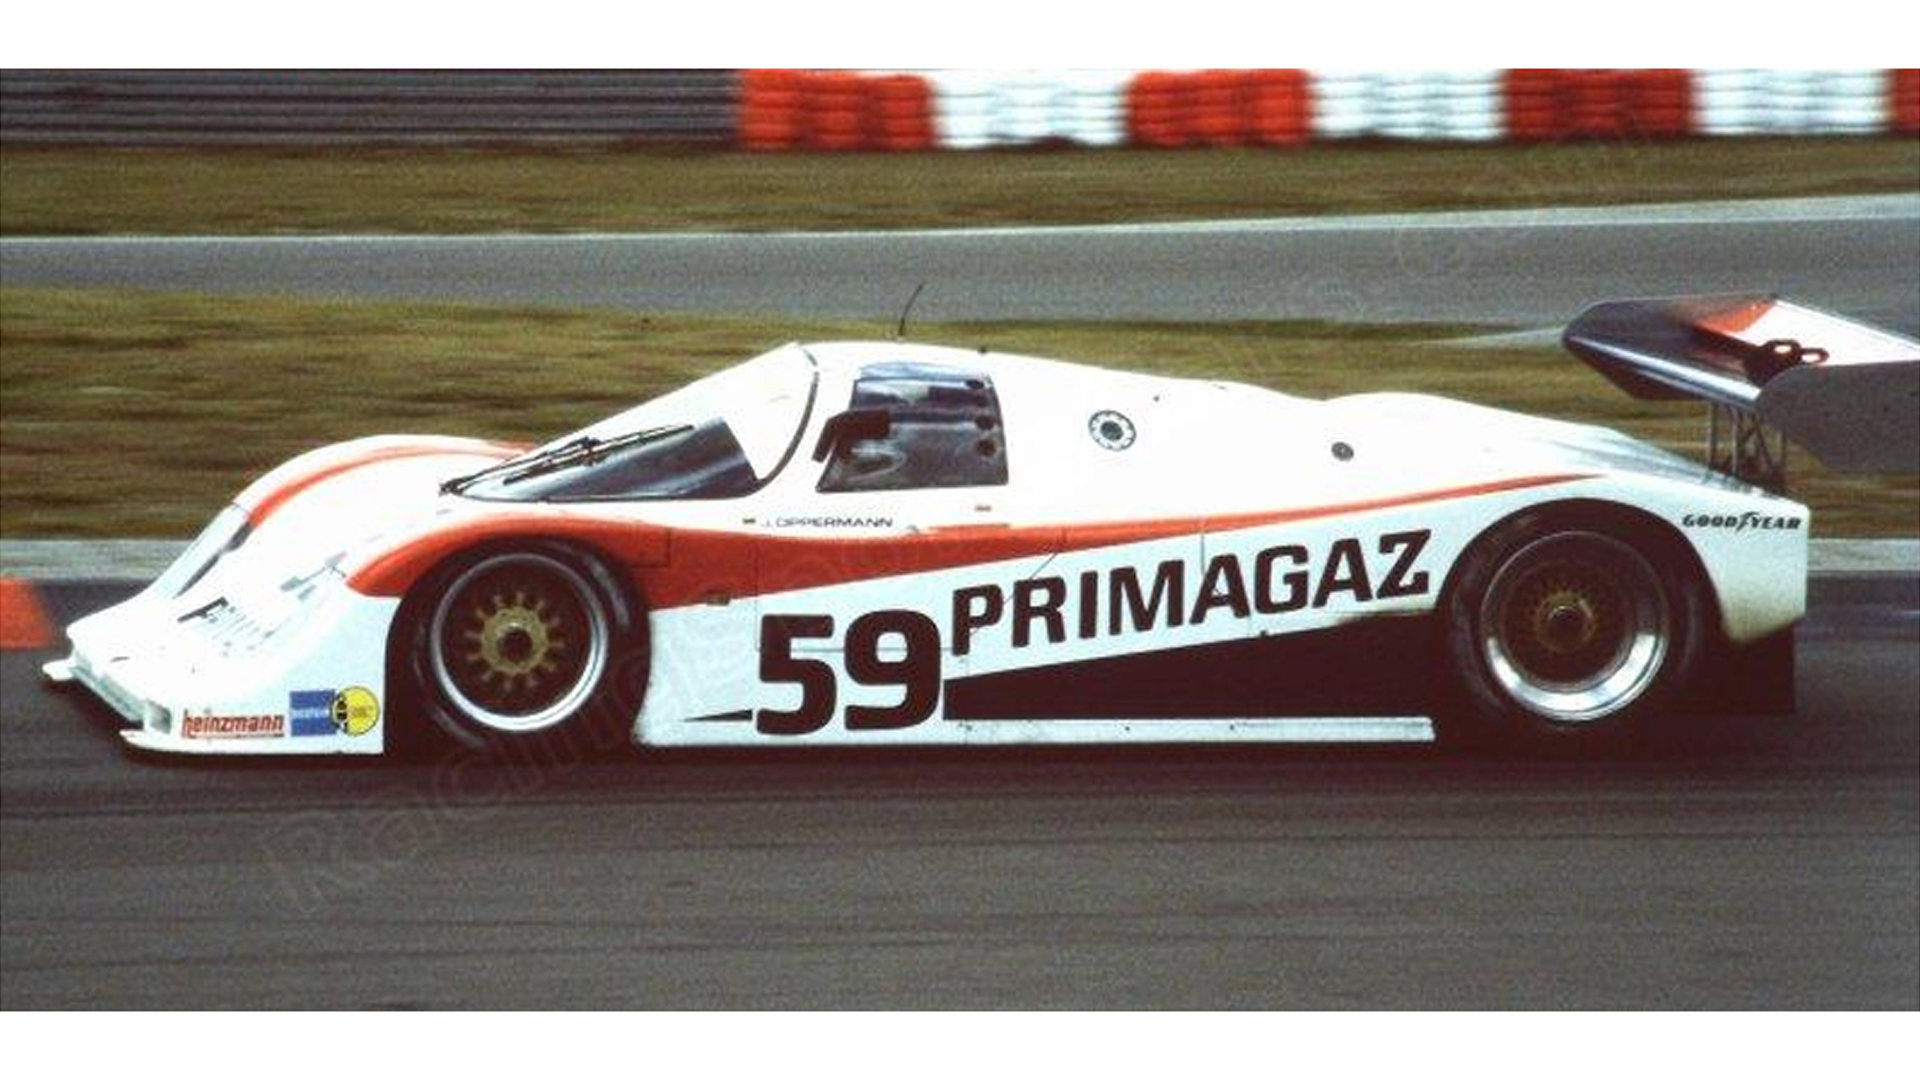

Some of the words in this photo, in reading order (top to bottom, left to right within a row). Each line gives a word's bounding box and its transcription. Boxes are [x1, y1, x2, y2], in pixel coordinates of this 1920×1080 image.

[1682, 511, 1802, 533] GOODYEAR
[951, 528, 1432, 656] PRIMAGAZ
[756, 608, 942, 736] 59
[181, 708, 285, 738] heinzmann
